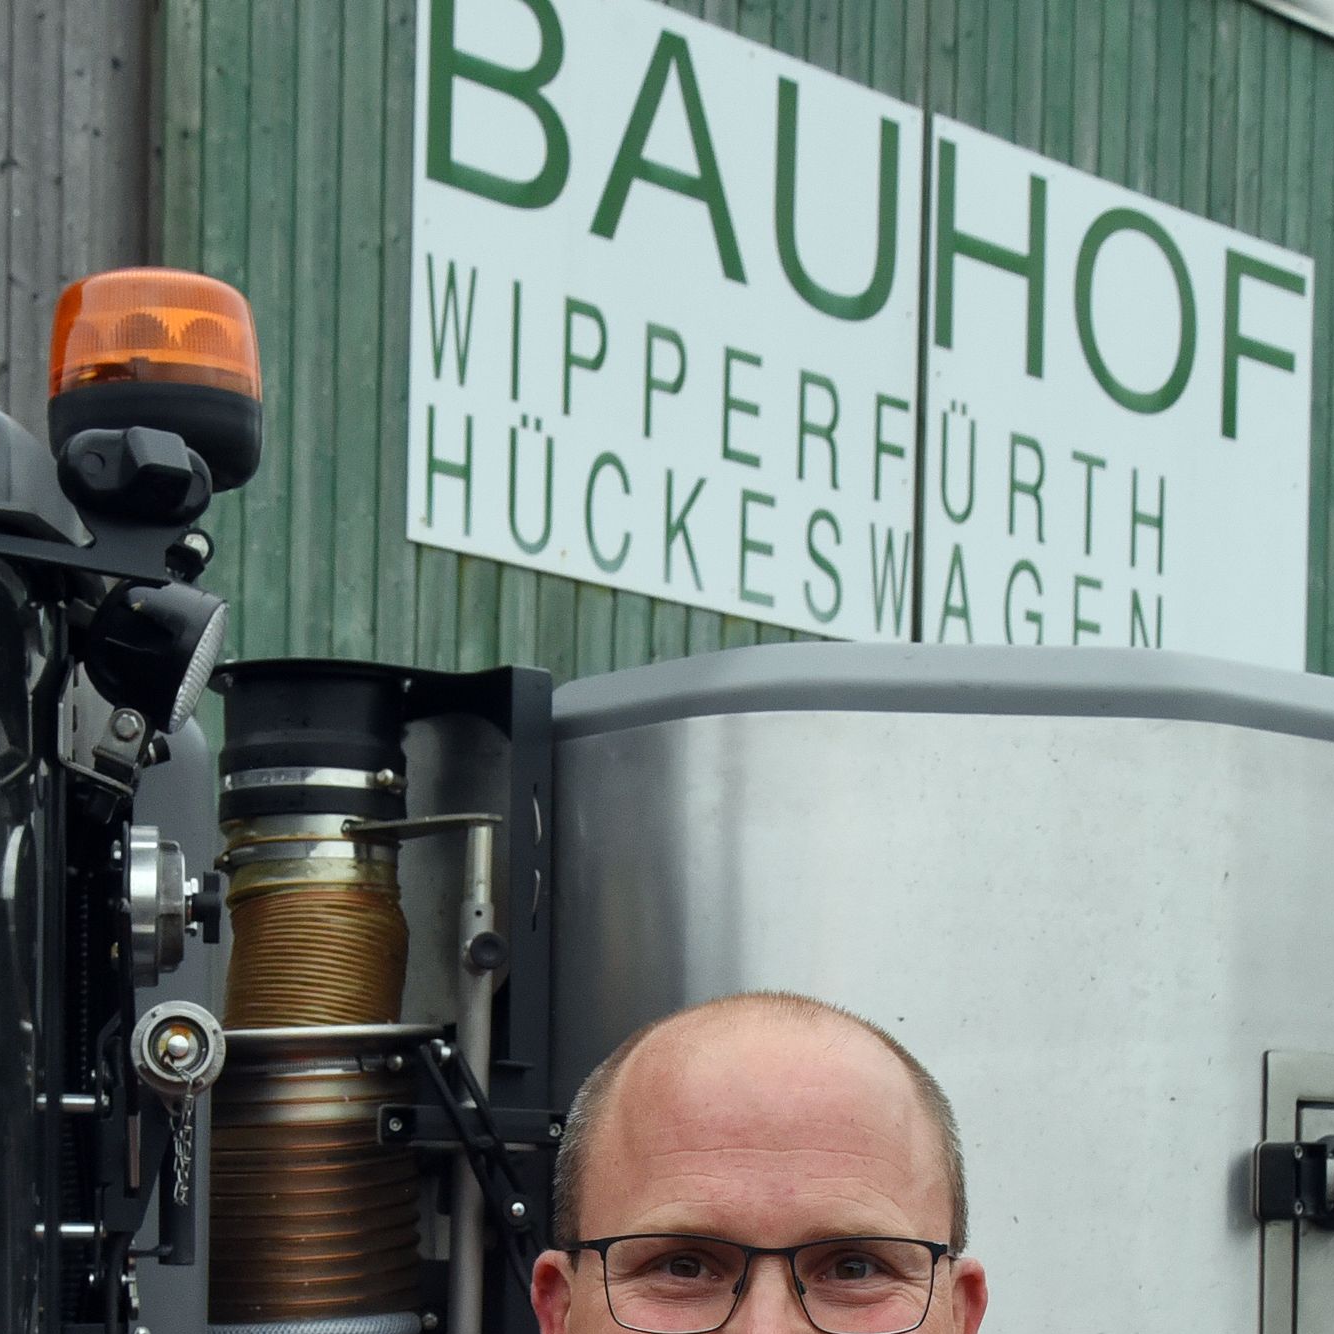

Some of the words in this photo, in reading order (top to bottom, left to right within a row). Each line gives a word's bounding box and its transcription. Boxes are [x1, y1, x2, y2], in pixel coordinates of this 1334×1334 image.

[426, 0, 1307, 440] BAUHOF
[426, 251, 1166, 577] WIPPERFÜRTH
[426, 403, 1165, 649] HÜCKESWAGEN
